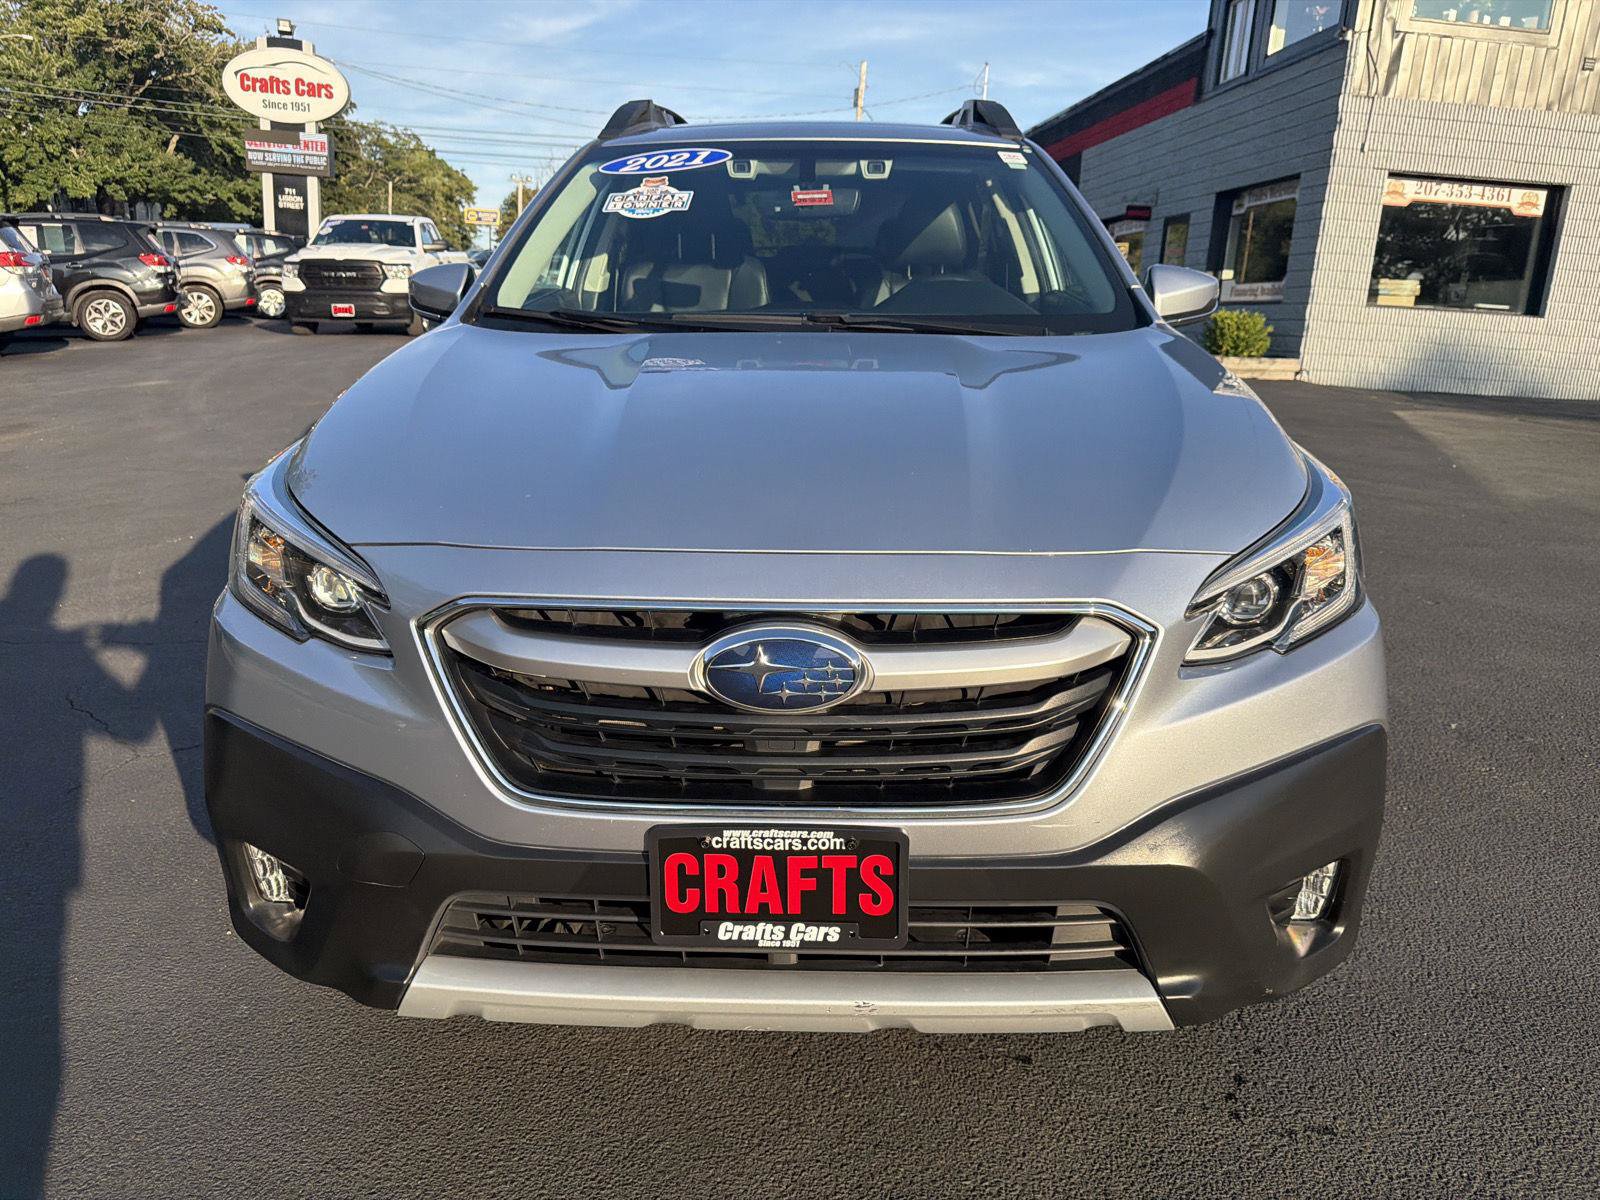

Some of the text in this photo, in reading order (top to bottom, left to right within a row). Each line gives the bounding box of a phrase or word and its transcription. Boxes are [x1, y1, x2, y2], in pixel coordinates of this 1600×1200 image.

[239, 72, 334, 100] Crafts Cars
[262, 99, 311, 113] Since 1951
[247, 151, 264, 161] NOW
[292, 154, 305, 164] THE
[304, 155, 328, 166] PUBLIC
[618, 151, 712, 172] 2021
[284, 187, 297, 195] 711
[1413, 181, 1513, 203] 207-353-4361
[278, 202, 304, 210] STREET
[623, 201, 684, 209] OWNER
[722, 828, 834, 839] www.craftscars.com
[711, 835, 846, 850] craftscars.com
[664, 852, 895, 917] CRAFTS
[717, 921, 841, 942] Crafts Cars
[757, 939, 781, 947] Since
